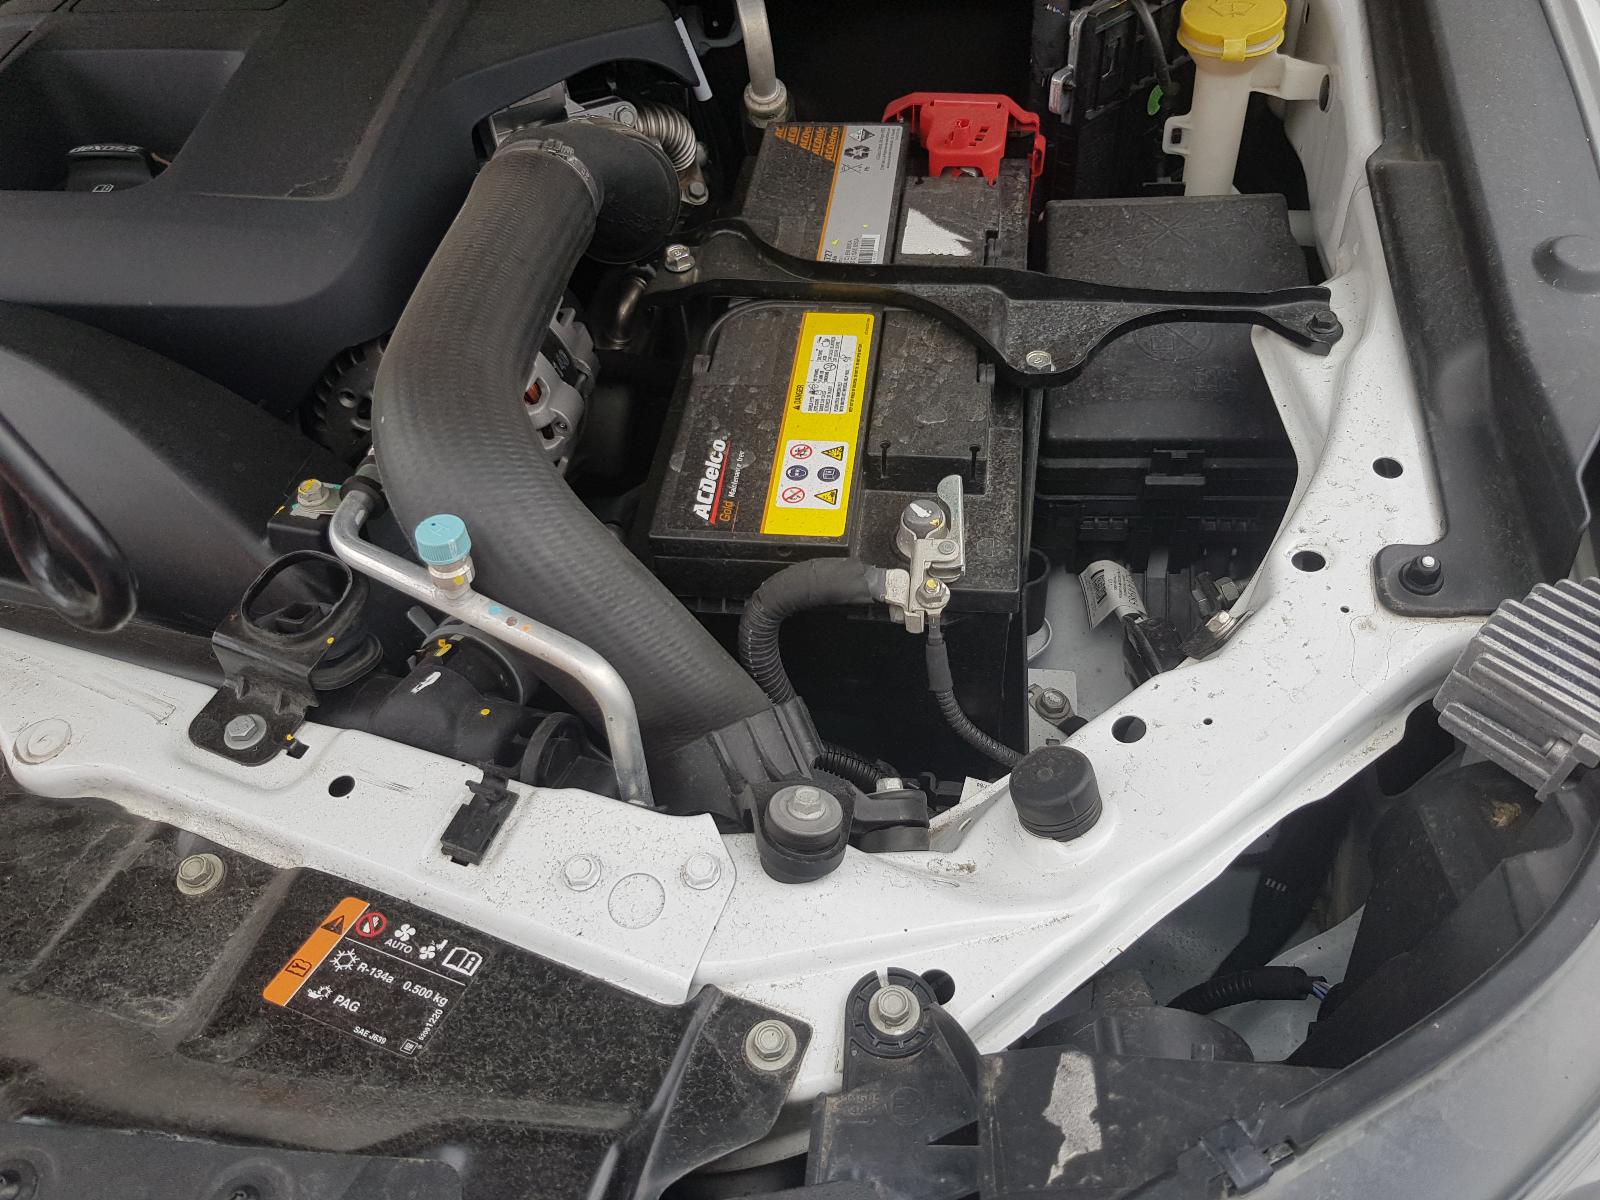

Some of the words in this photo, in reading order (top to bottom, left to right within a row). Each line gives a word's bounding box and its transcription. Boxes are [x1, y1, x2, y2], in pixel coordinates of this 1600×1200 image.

[825, 126, 839, 161] ACDelco
[793, 384, 804, 405] DANGER
[693, 439, 726, 521] ACDelco
[719, 501, 733, 522] Gold
[728, 464, 742, 498] Maintenance
[737, 450, 745, 463] free
[384, 938, 413, 954] AUTO
[356, 962, 394, 984] R-134a
[402, 981, 434, 999] 0.500
[432, 993, 449, 1008] kg
[332, 994, 361, 1013] PAG
[353, 1026, 369, 1038] SAE
[369, 1033, 387, 1045] J639
